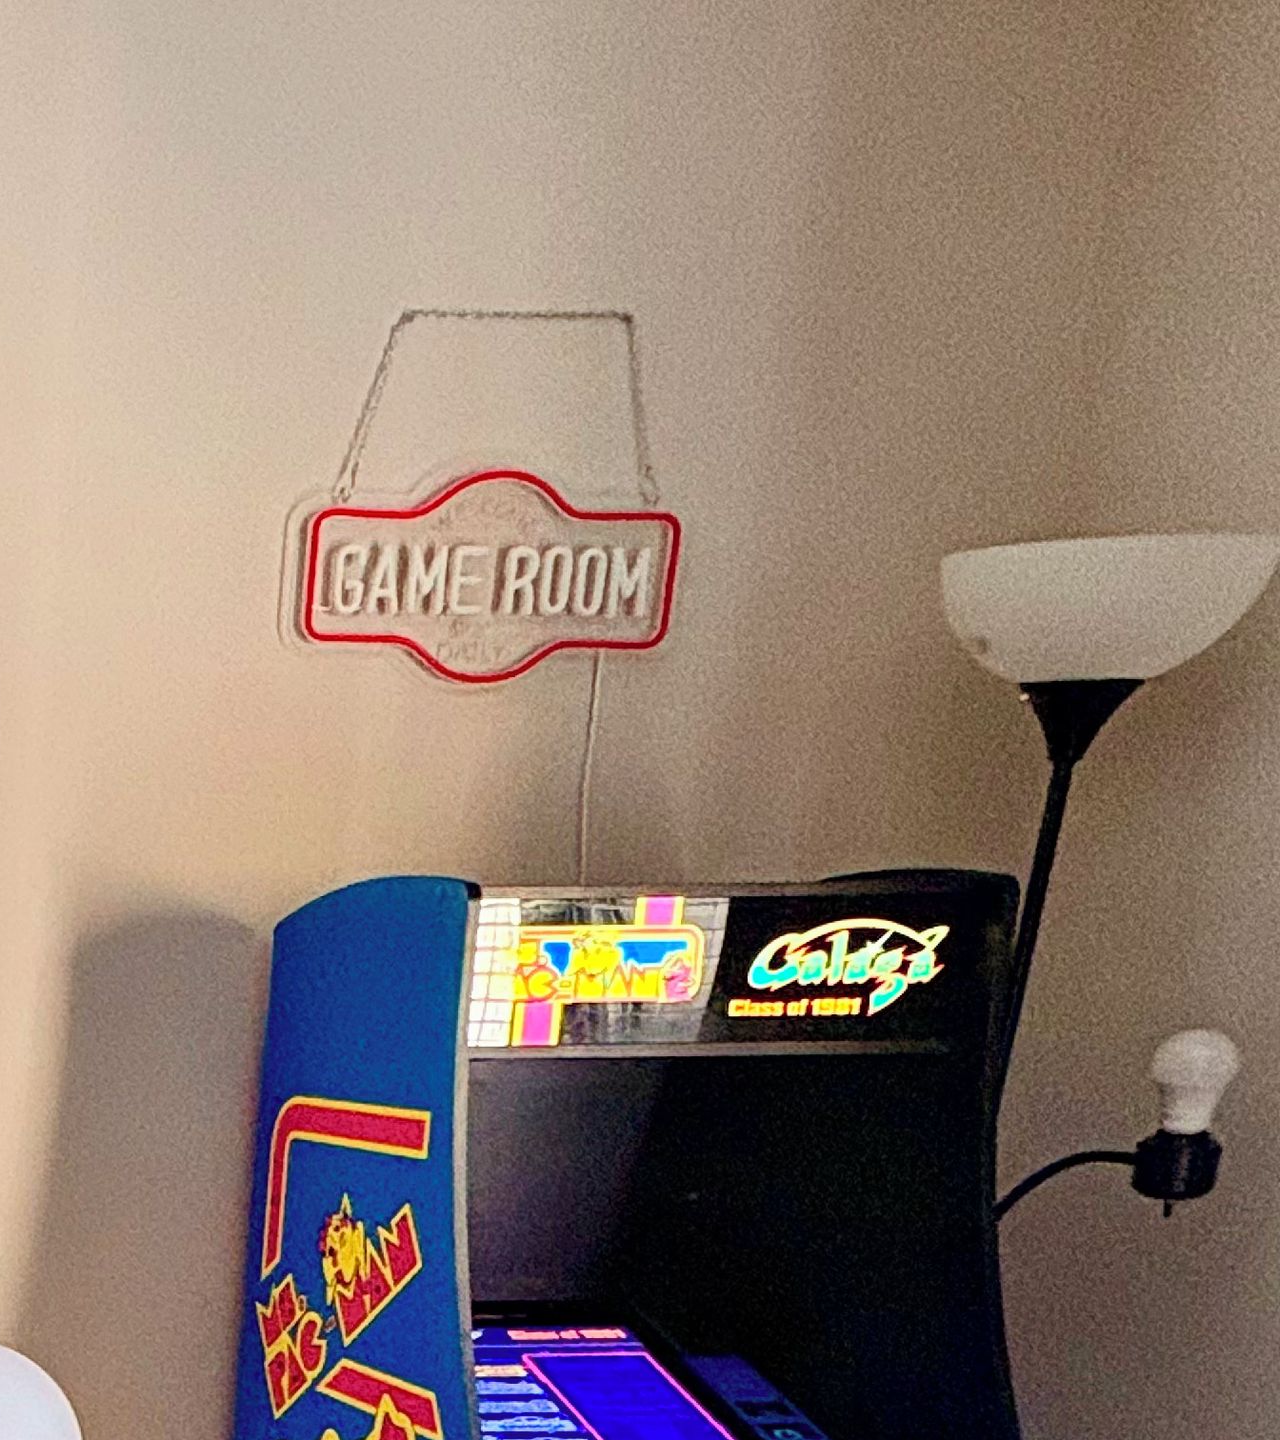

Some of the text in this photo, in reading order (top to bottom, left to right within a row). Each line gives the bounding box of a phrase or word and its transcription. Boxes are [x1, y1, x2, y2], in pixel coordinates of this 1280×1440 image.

[335, 544, 651, 618] GAME ROOM
[747, 918, 950, 1017] Galaga
[728, 997, 862, 1017] Class of 1981
